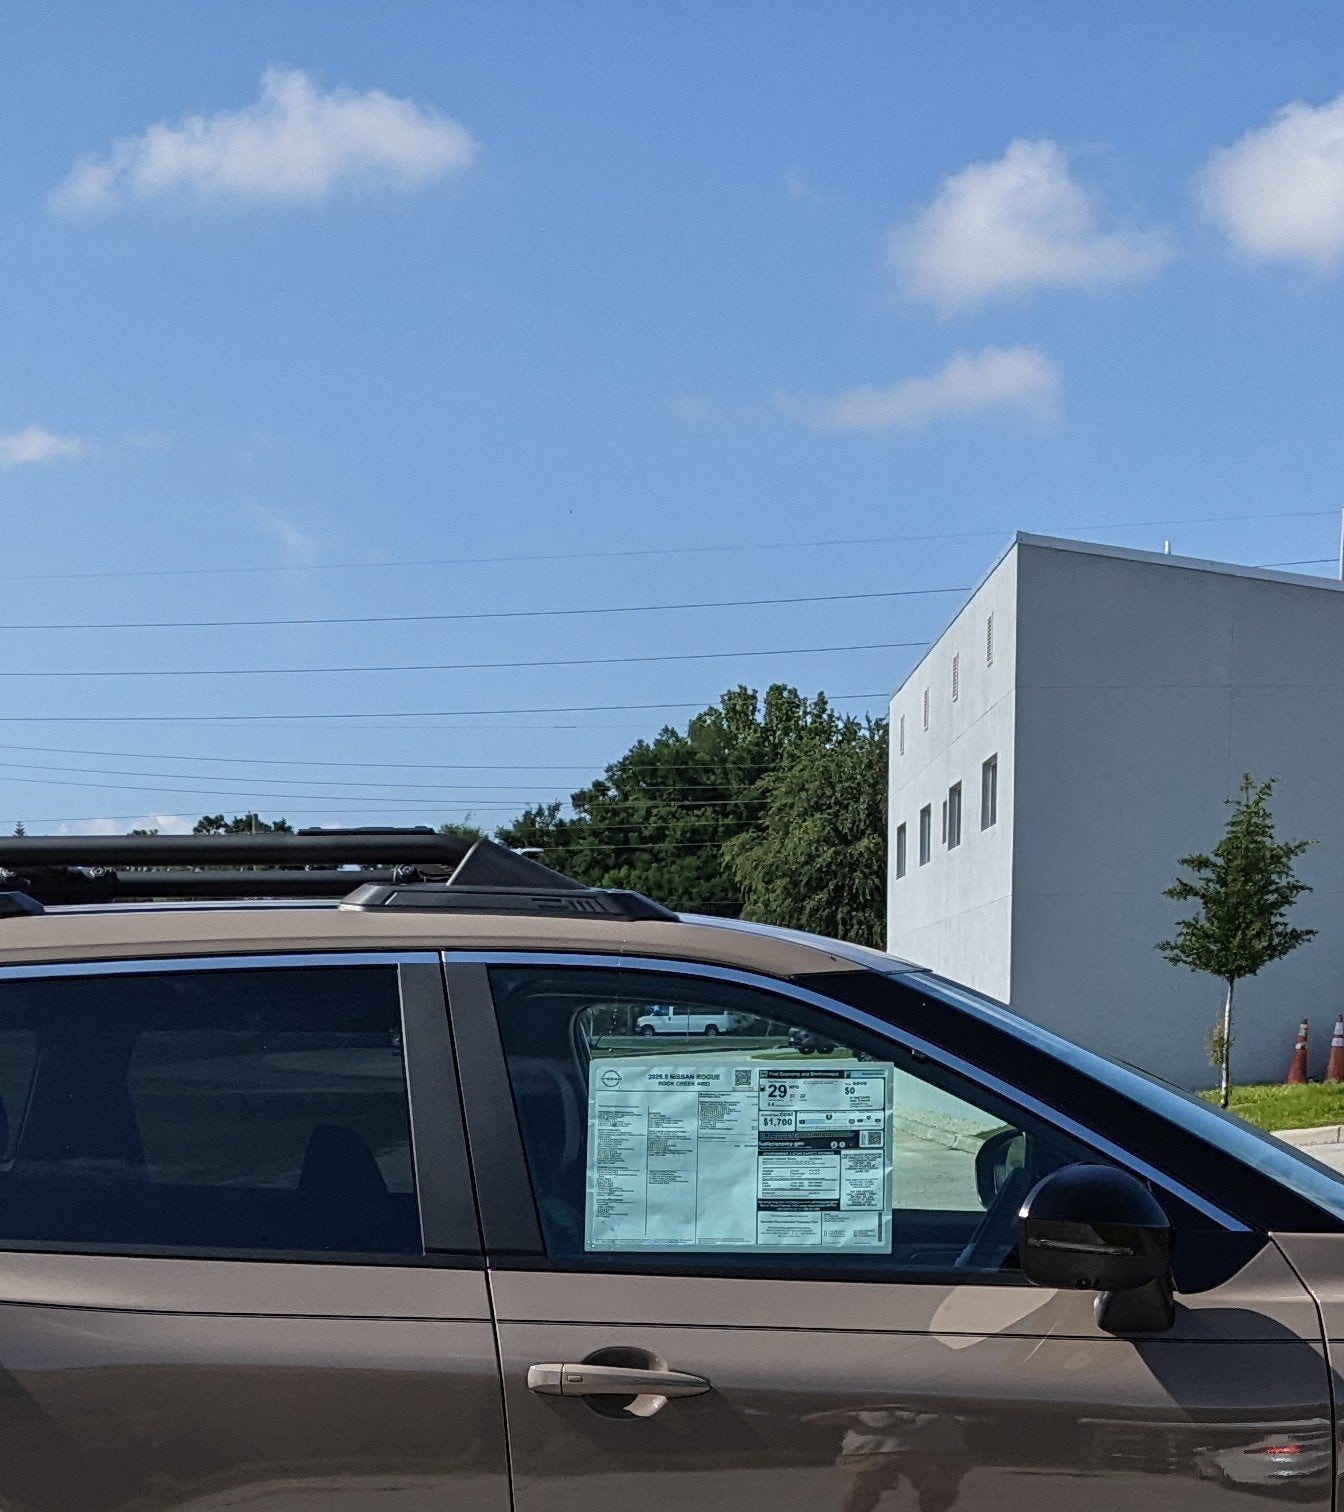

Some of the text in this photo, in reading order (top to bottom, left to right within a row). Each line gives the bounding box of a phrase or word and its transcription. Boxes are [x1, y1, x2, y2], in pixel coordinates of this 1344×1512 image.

[768, 1084, 787, 1098] 29
[844, 1087, 856, 1095] $0
[763, 1118, 792, 1127] $1,700
